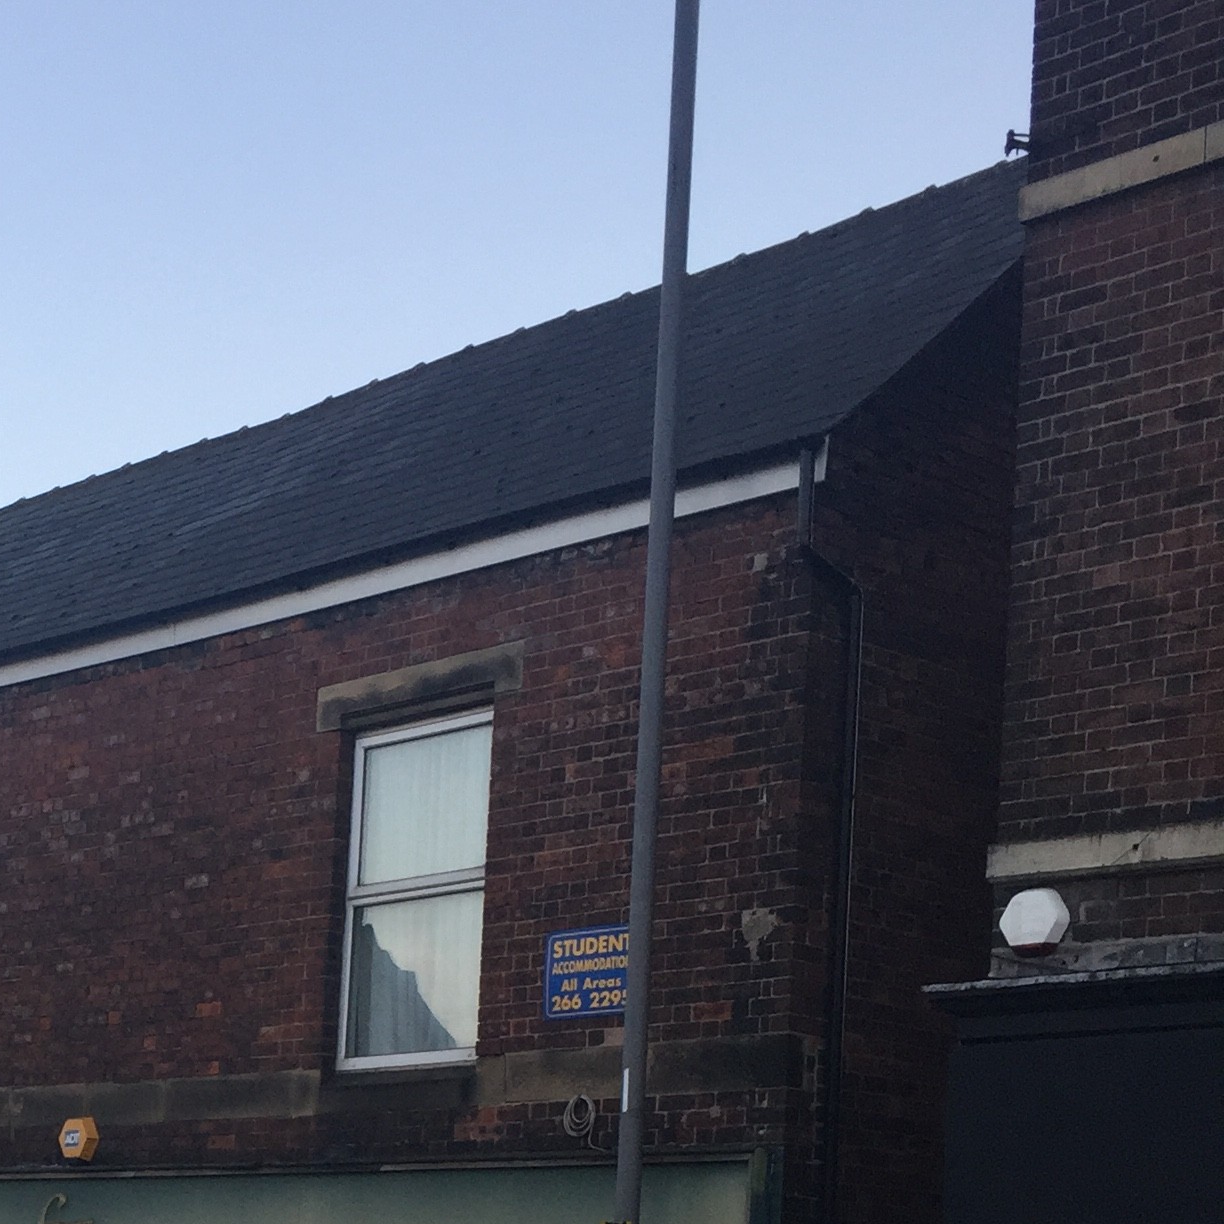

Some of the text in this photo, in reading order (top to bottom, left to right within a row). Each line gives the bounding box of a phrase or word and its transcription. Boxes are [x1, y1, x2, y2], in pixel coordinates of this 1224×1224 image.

[552, 933, 630, 959] STUDENT
[560, 977, 622, 992] All Areas
[551, 993, 582, 1012] 266
